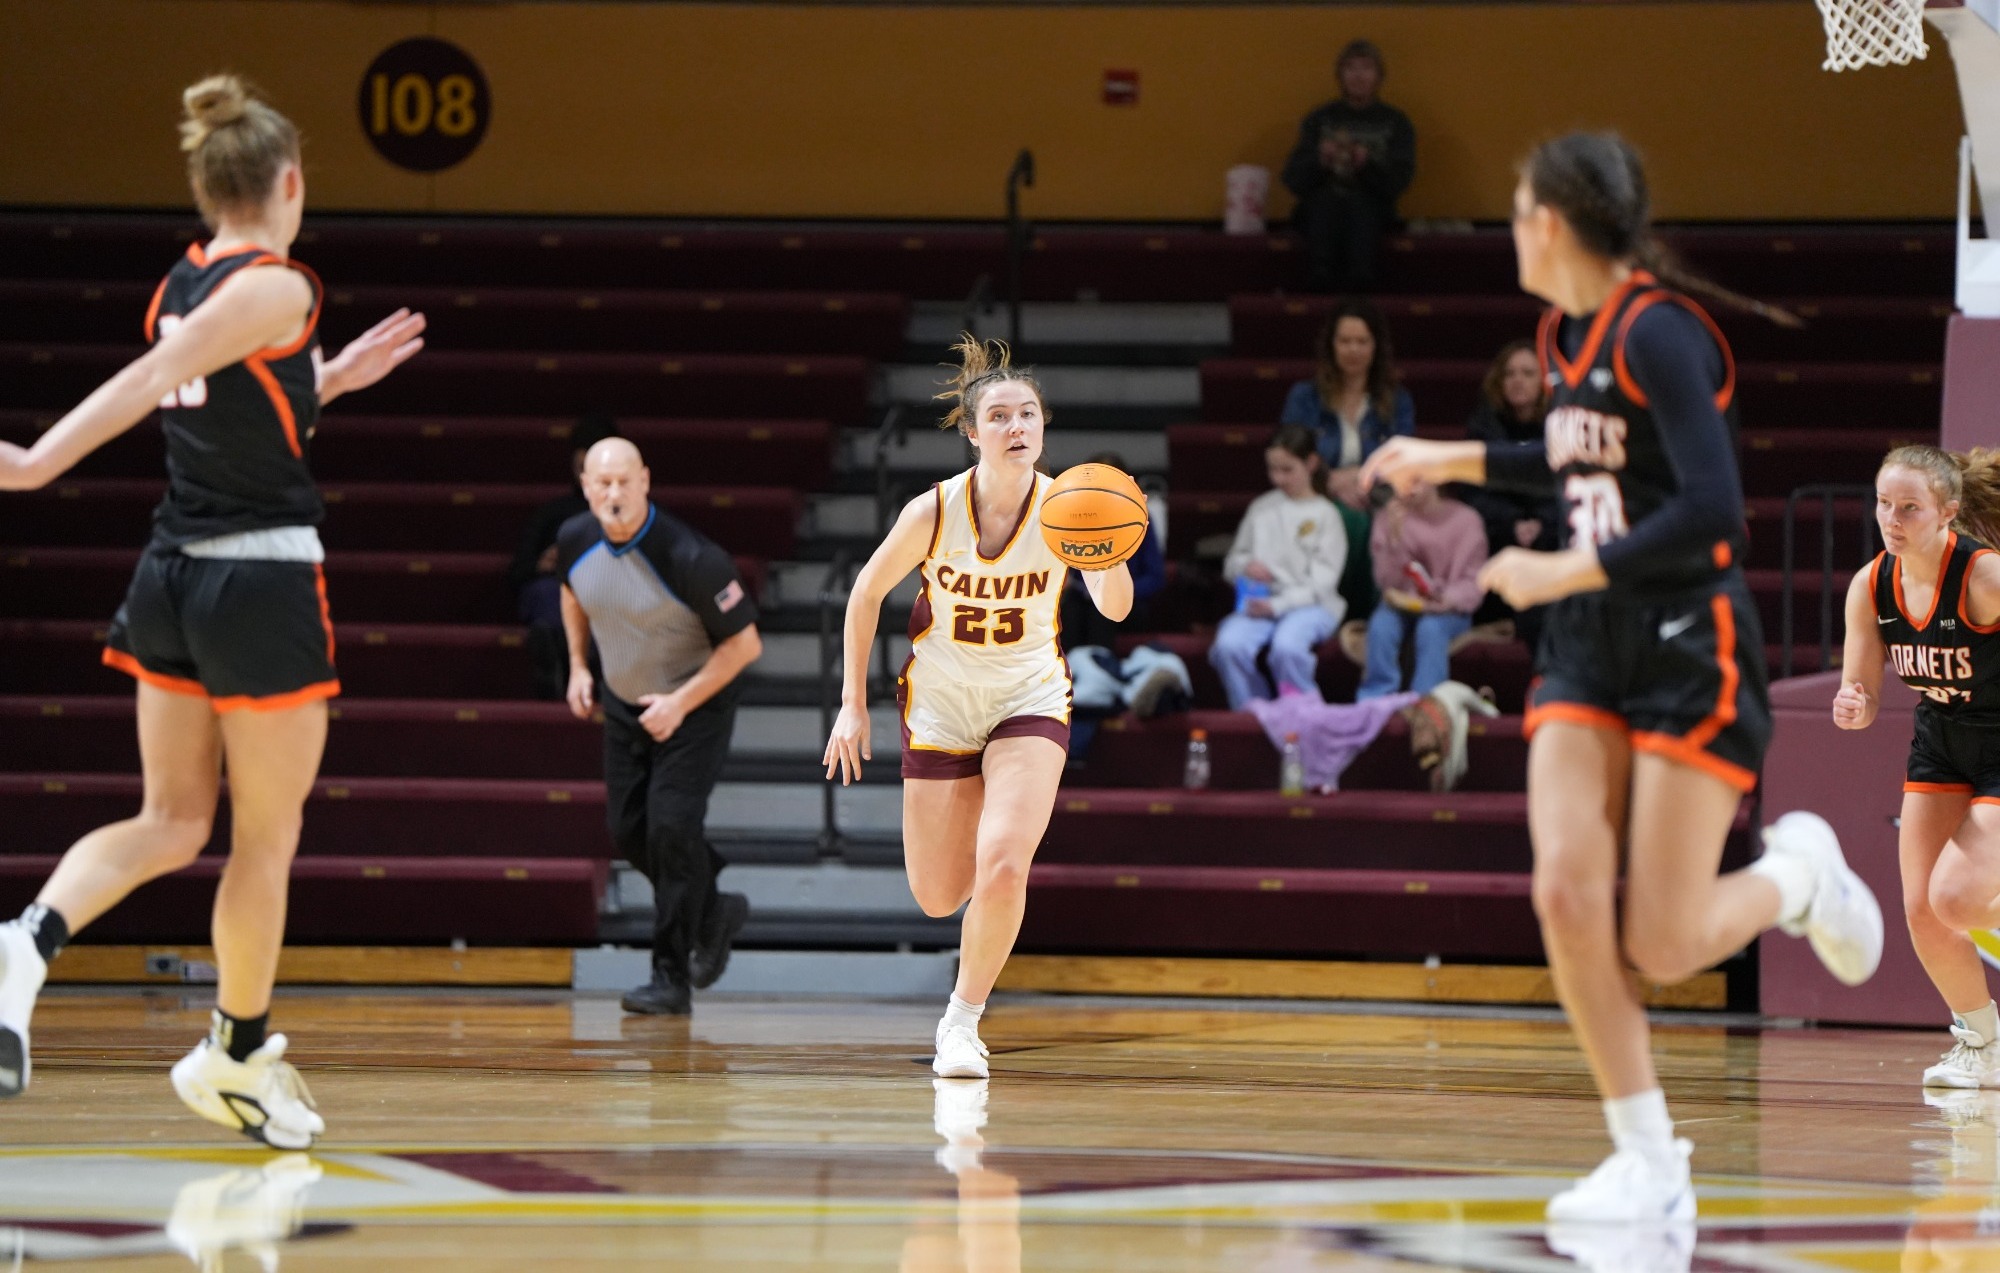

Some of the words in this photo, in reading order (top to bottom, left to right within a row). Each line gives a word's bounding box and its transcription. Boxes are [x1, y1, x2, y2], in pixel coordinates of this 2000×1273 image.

[373, 72, 475, 136] 108
[1060, 541, 1114, 557] NCAA
[936, 564, 1051, 600] CALVIN
[952, 604, 1026, 647] 23
[1886, 644, 1973, 680] ORNETS
